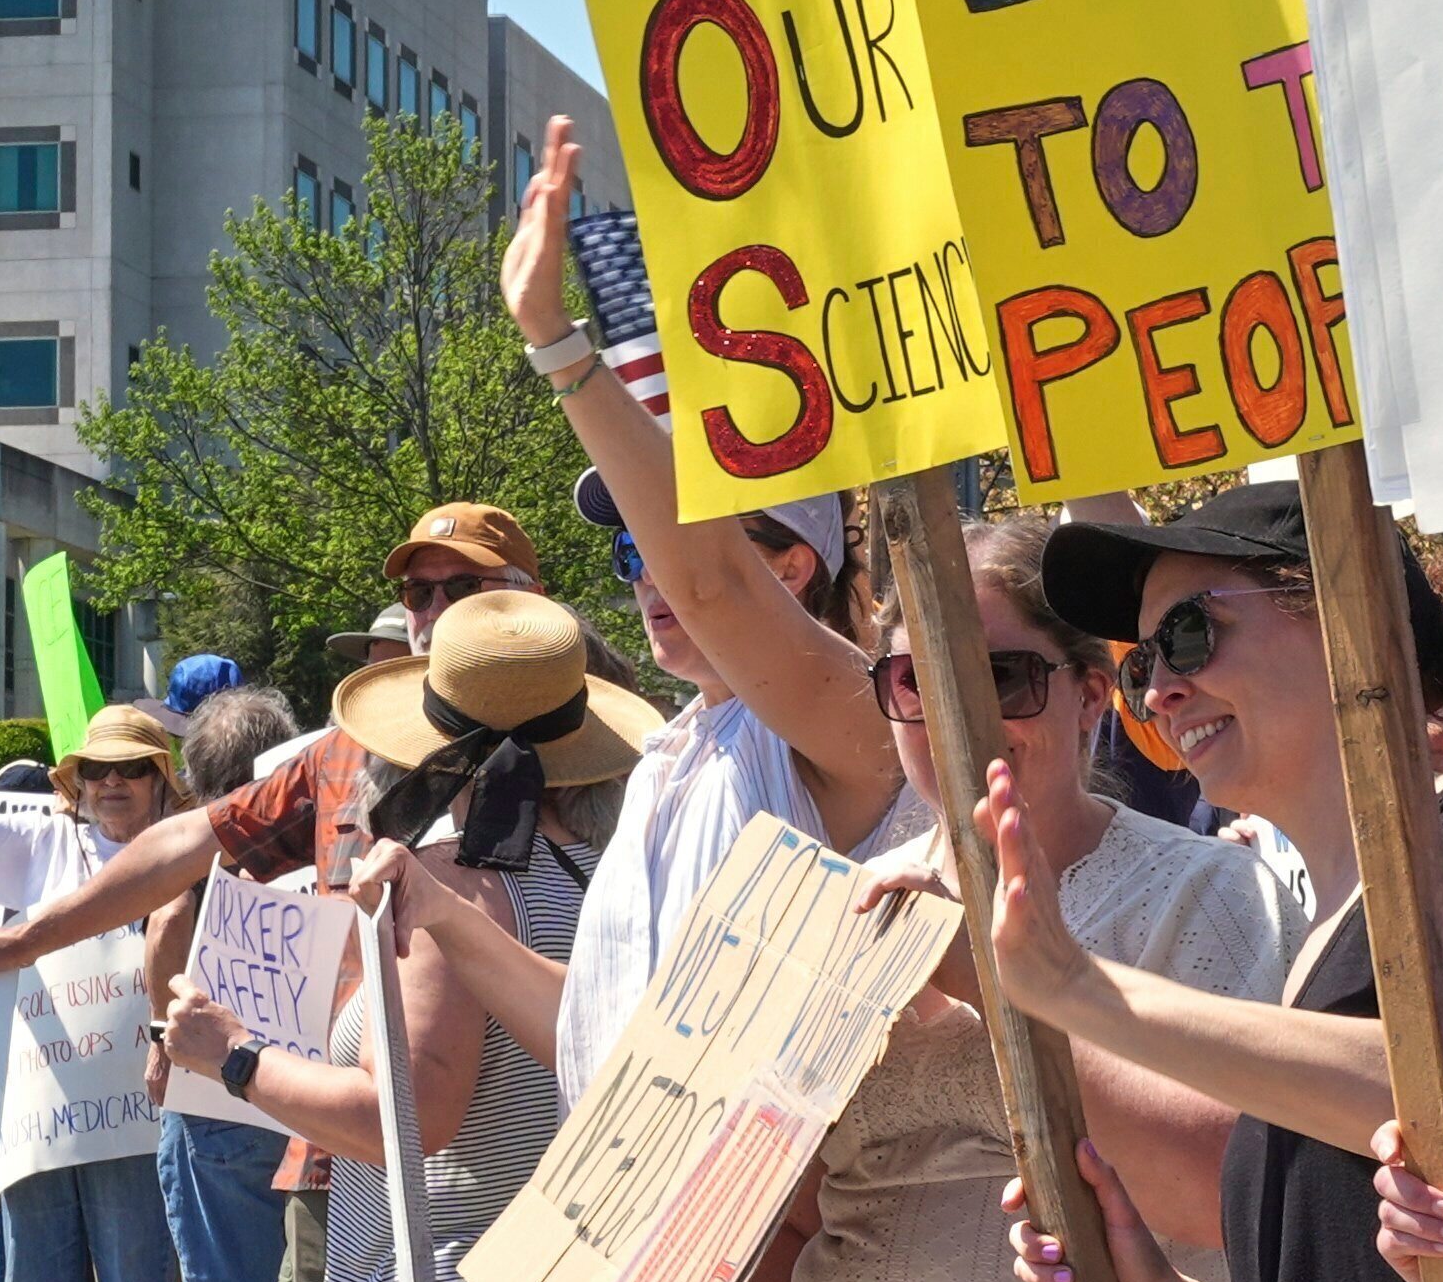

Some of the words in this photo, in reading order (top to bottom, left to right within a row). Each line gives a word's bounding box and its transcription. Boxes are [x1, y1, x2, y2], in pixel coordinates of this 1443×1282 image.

[965, 76, 1200, 248] TO
[688, 236, 991, 478] SCIENC
[204, 878, 304, 968] ORKER
[18, 983, 61, 1020] GOLF
[66, 971, 124, 1008] USING
[198, 945, 308, 1035] SAFETY
[20, 1030, 112, 1073] PHOTO-OPS
[542, 1051, 726, 1258] NEEDS
